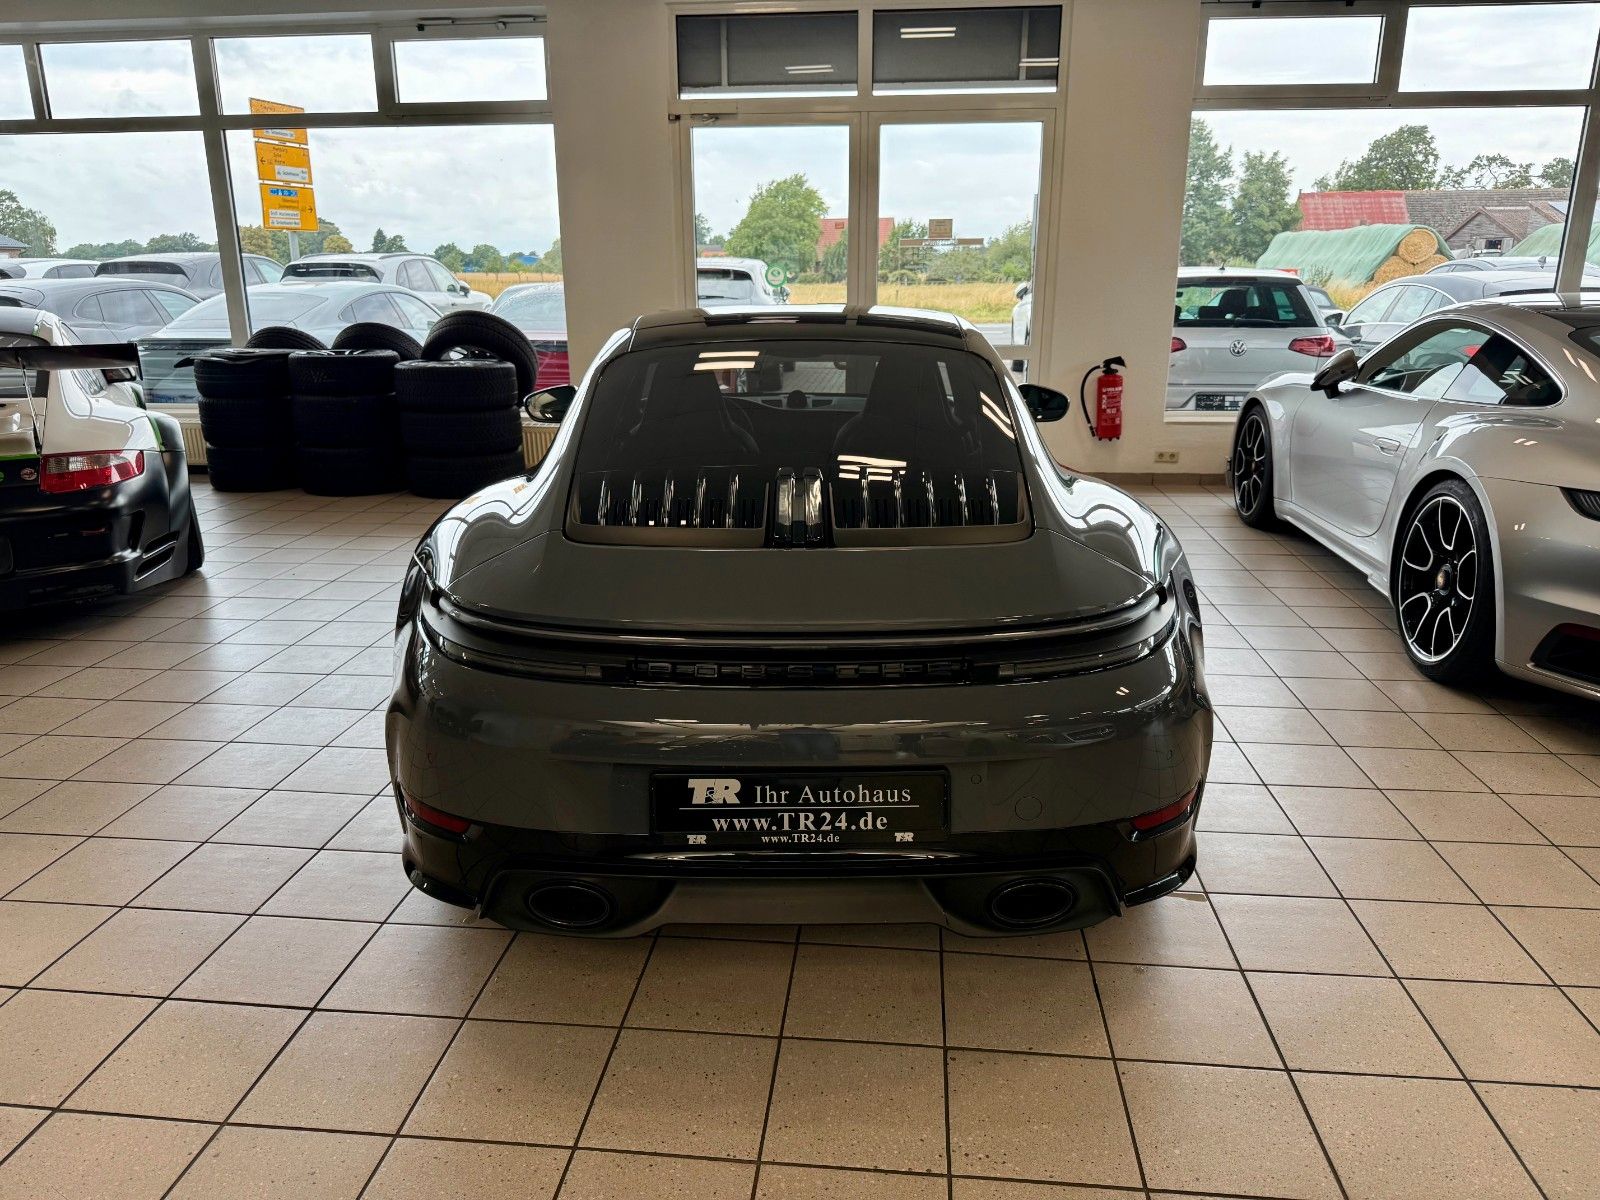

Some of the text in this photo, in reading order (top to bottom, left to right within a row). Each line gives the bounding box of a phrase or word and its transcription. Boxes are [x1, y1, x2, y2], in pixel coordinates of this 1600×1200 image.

[754, 784, 790, 804] Ihr
[797, 783, 912, 804] Autohaus
[711, 811, 888, 832] www.TR24.de
[761, 833, 840, 843] www.TR24.de
